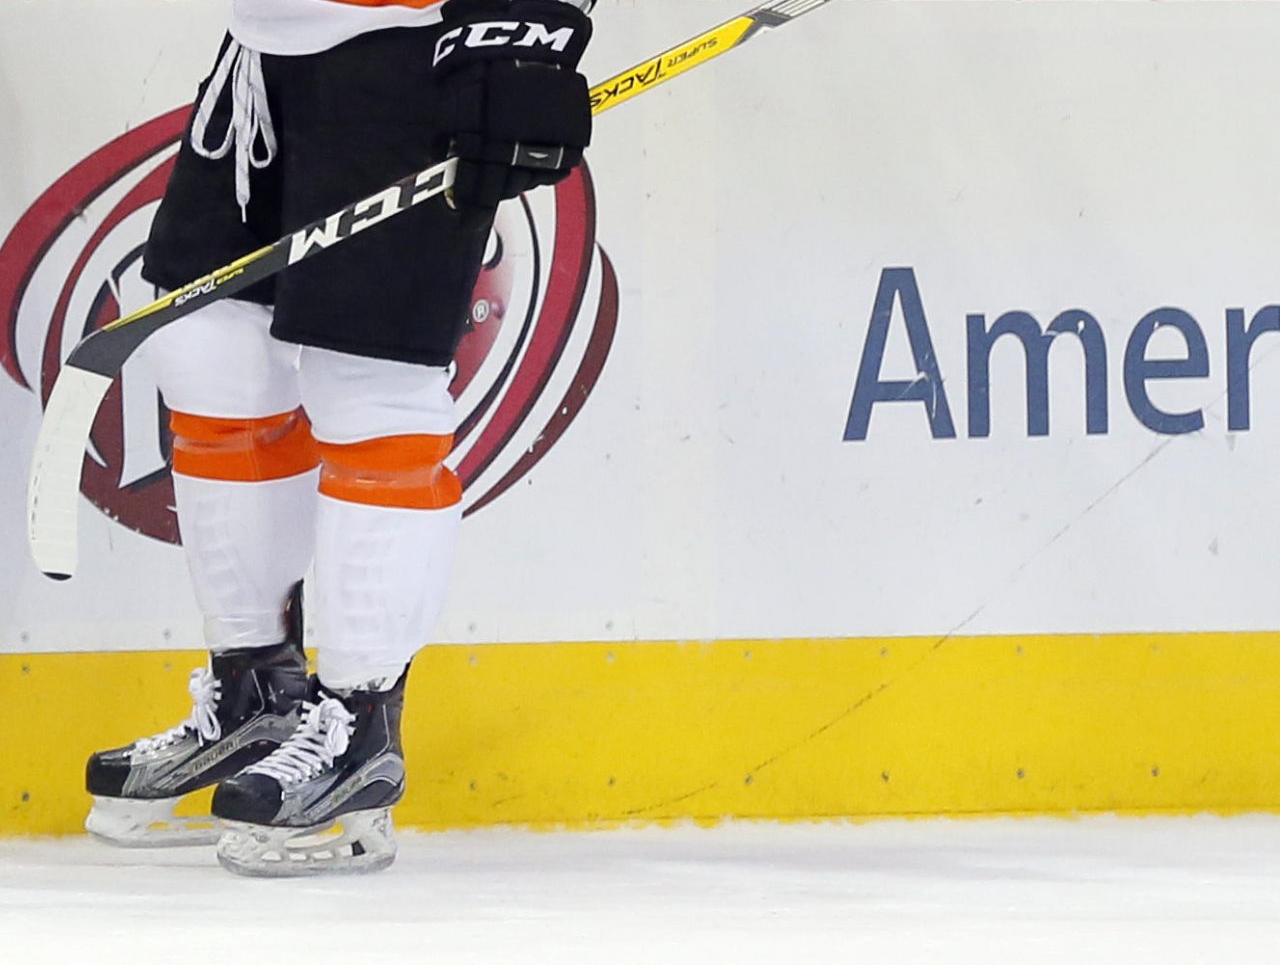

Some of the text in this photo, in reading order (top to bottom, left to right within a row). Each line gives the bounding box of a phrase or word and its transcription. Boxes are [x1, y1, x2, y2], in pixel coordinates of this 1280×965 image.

[432, 21, 575, 67] CCM
[287, 156, 460, 266] CCM
[842, 266, 1280, 442] Amer
